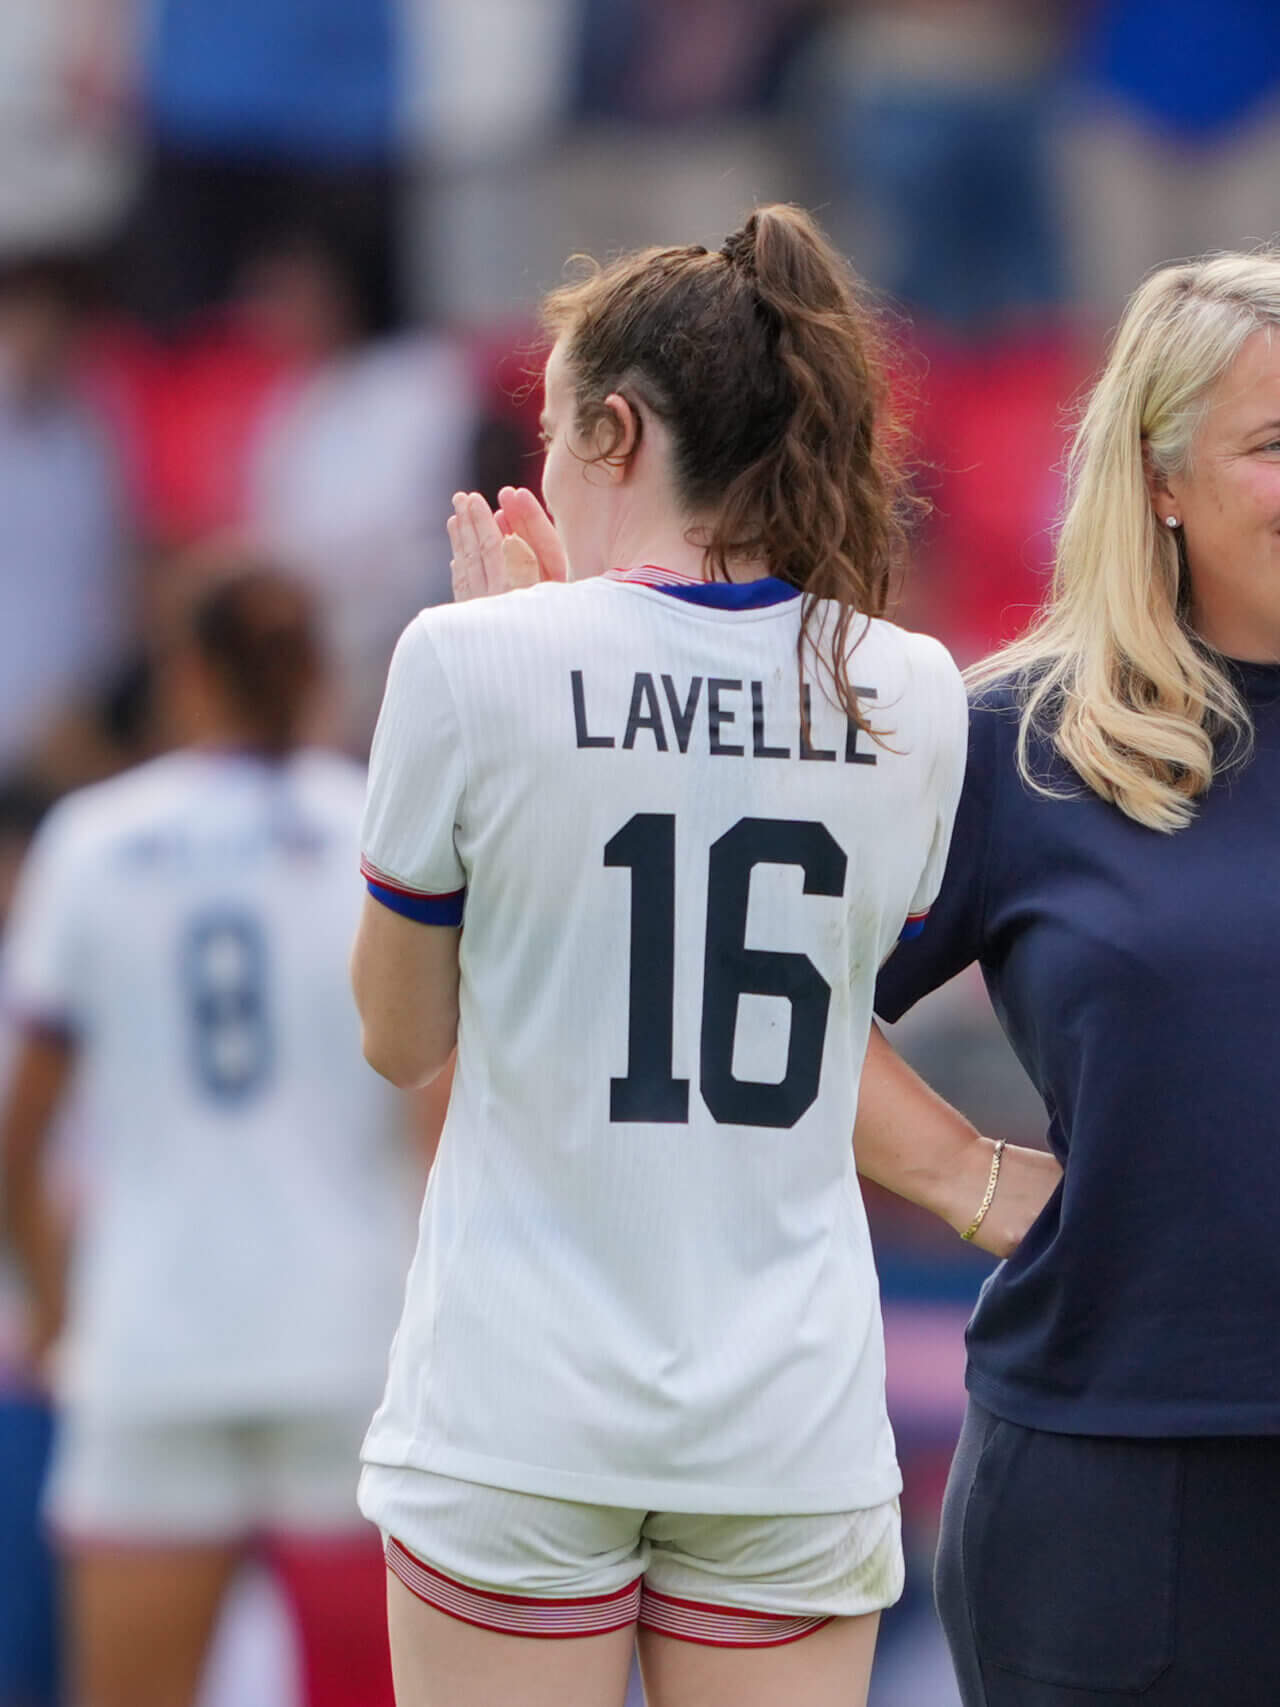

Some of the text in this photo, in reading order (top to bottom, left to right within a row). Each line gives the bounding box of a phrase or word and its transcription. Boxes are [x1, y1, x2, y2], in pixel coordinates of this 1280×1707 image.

[571, 670, 877, 765] LAVELLE
[180, 902, 273, 1109] 8
[604, 813, 848, 1128] 16
